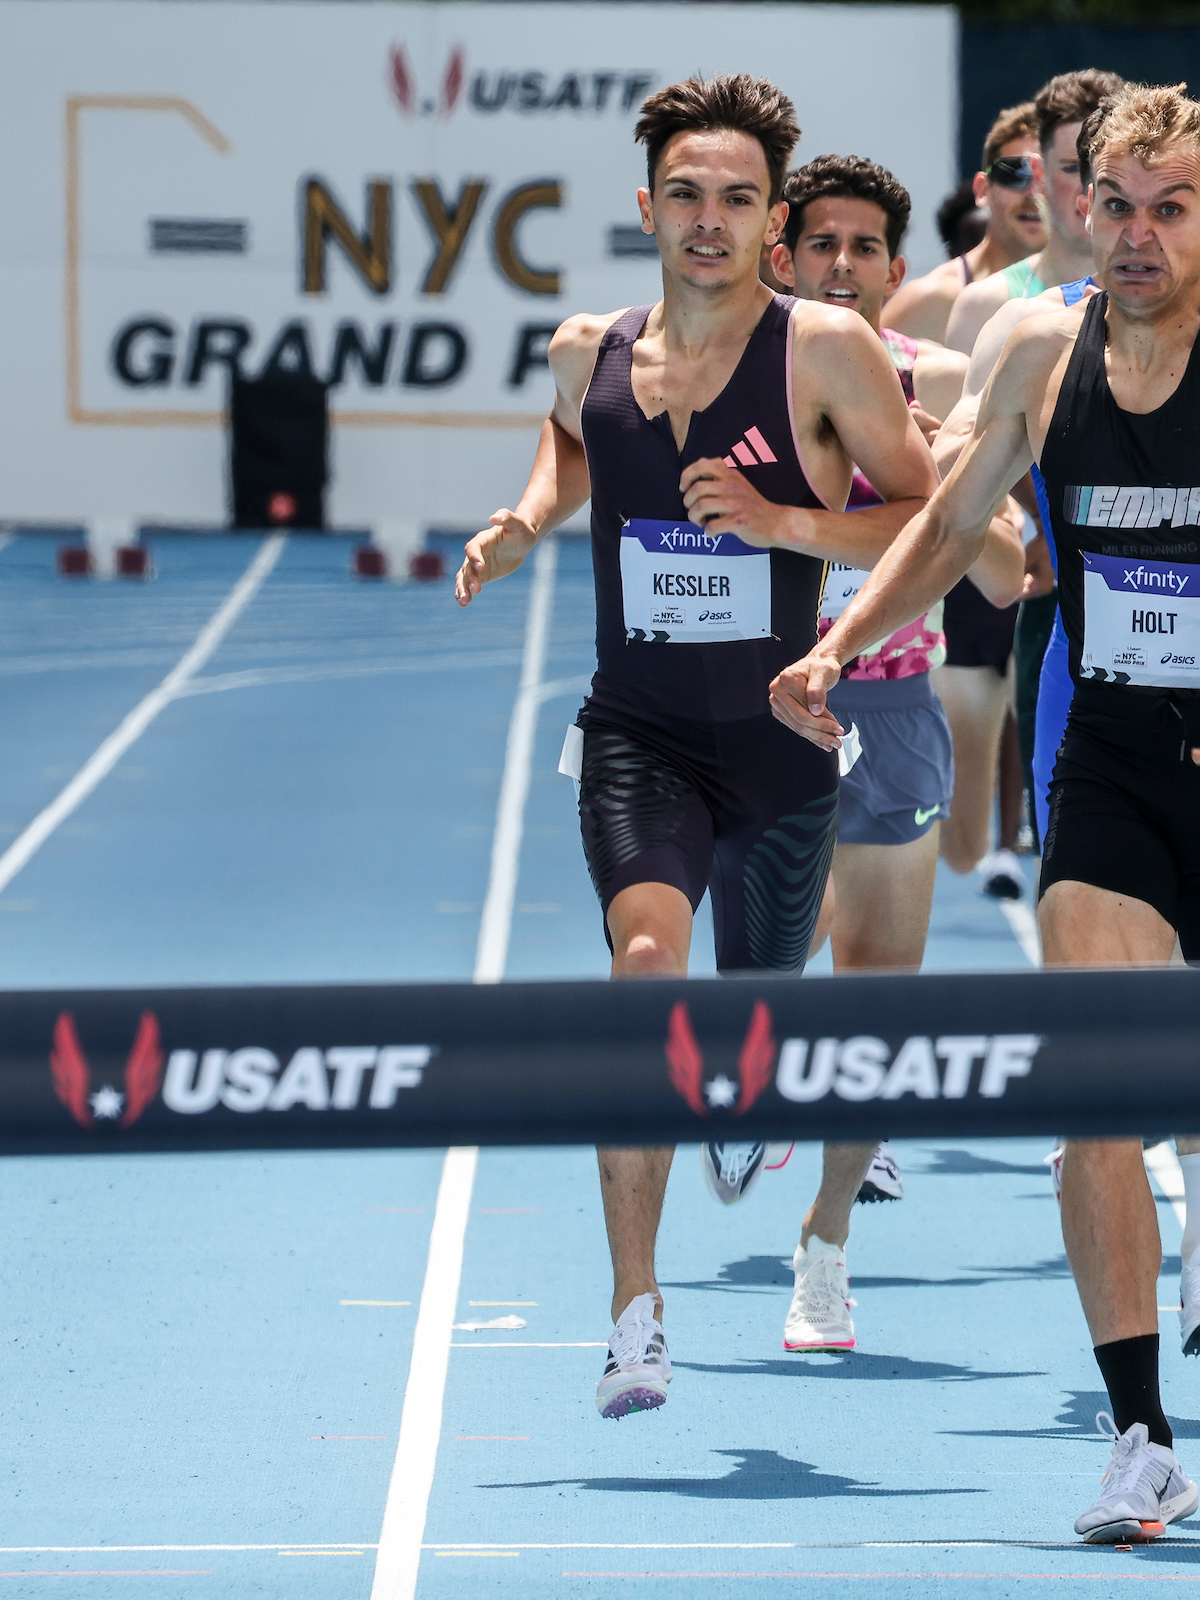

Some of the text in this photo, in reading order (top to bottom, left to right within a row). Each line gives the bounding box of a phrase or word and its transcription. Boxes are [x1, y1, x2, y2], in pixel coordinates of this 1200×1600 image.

[469, 68, 656, 115] USATF
[300, 174, 565, 297] NYC
[112, 317, 467, 388] GRAND
[659, 527, 723, 553] xfinity
[1101, 542, 1198, 556] MILER RUNNING
[653, 573, 730, 597] KESSLER
[1122, 565, 1190, 594] xfinity
[661, 612, 675, 620] NYC
[1131, 609, 1178, 635] HOLT
[1122, 652, 1137, 661] NYC
[162, 1045, 432, 1114] USATF
[776, 1034, 1041, 1102] USATF
